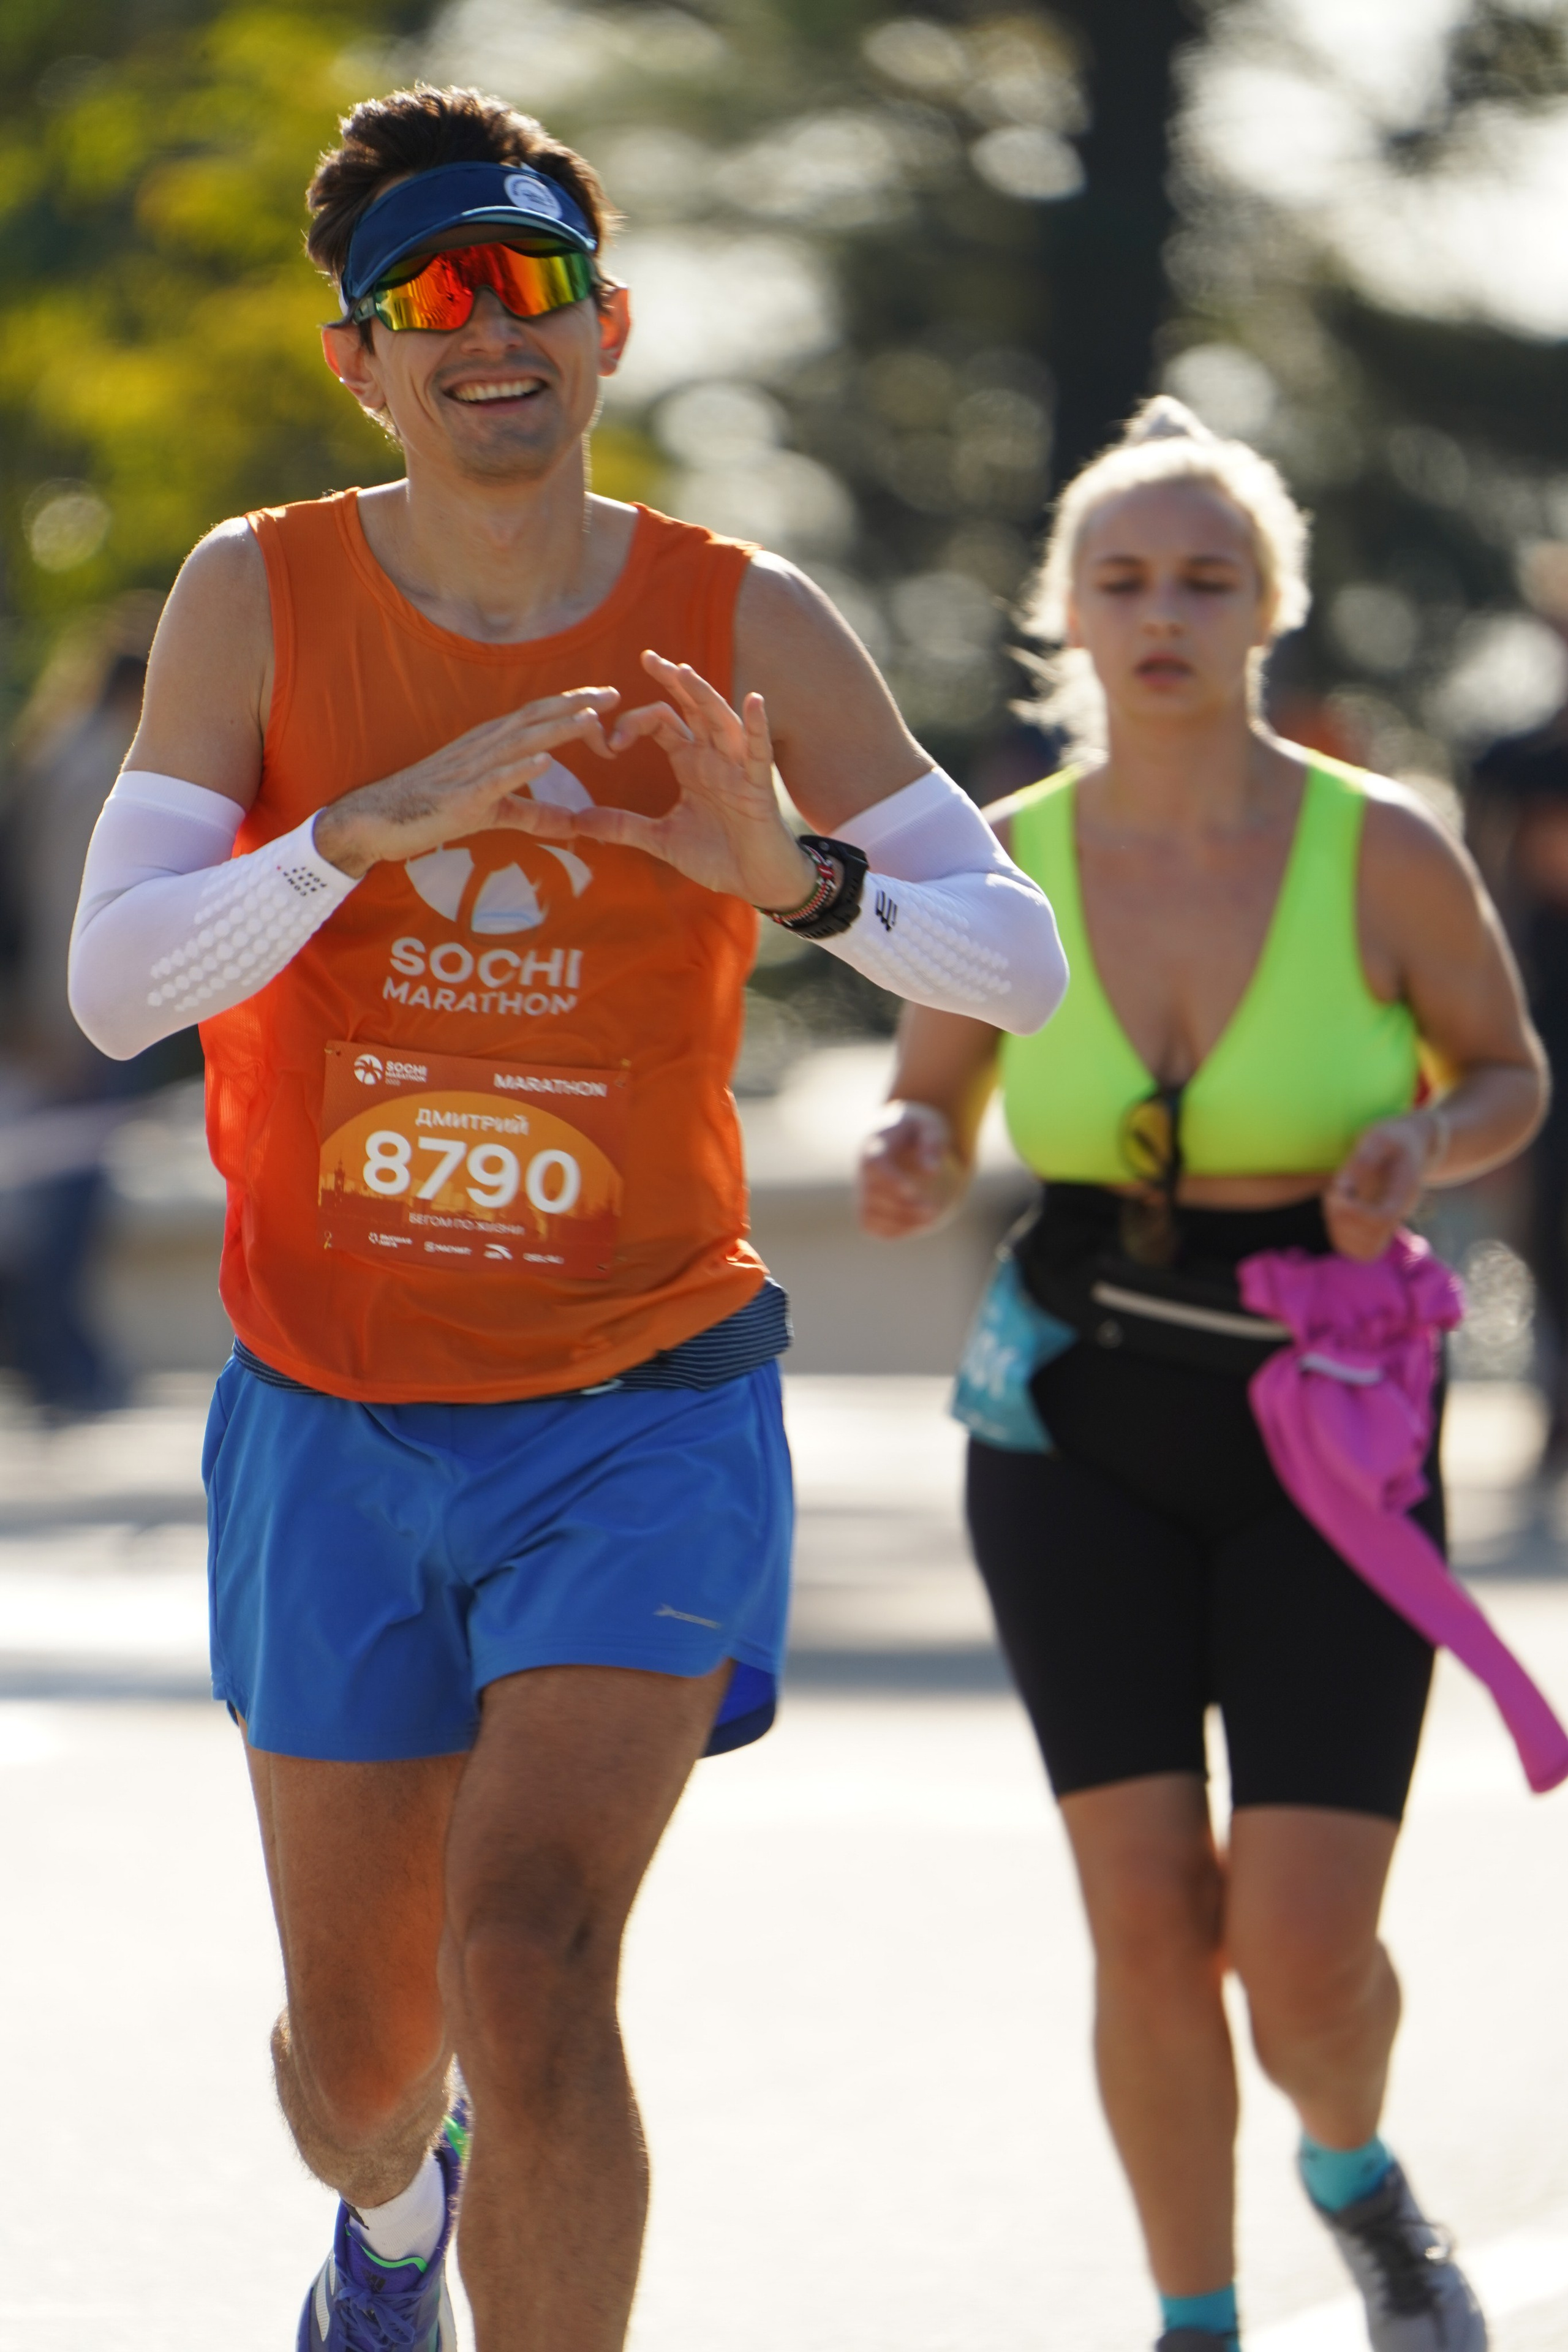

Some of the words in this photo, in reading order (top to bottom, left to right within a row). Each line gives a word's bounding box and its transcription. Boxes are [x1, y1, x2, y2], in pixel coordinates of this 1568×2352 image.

[390, 937, 582, 989] SOCHI
[382, 976, 577, 1016] MARATHON
[385, 1060, 428, 1077] SOCHI
[493, 1072, 608, 1098] MARATHON
[415, 1107, 529, 1136] ДМИТРИЙ
[363, 1130, 581, 1214] 8790
